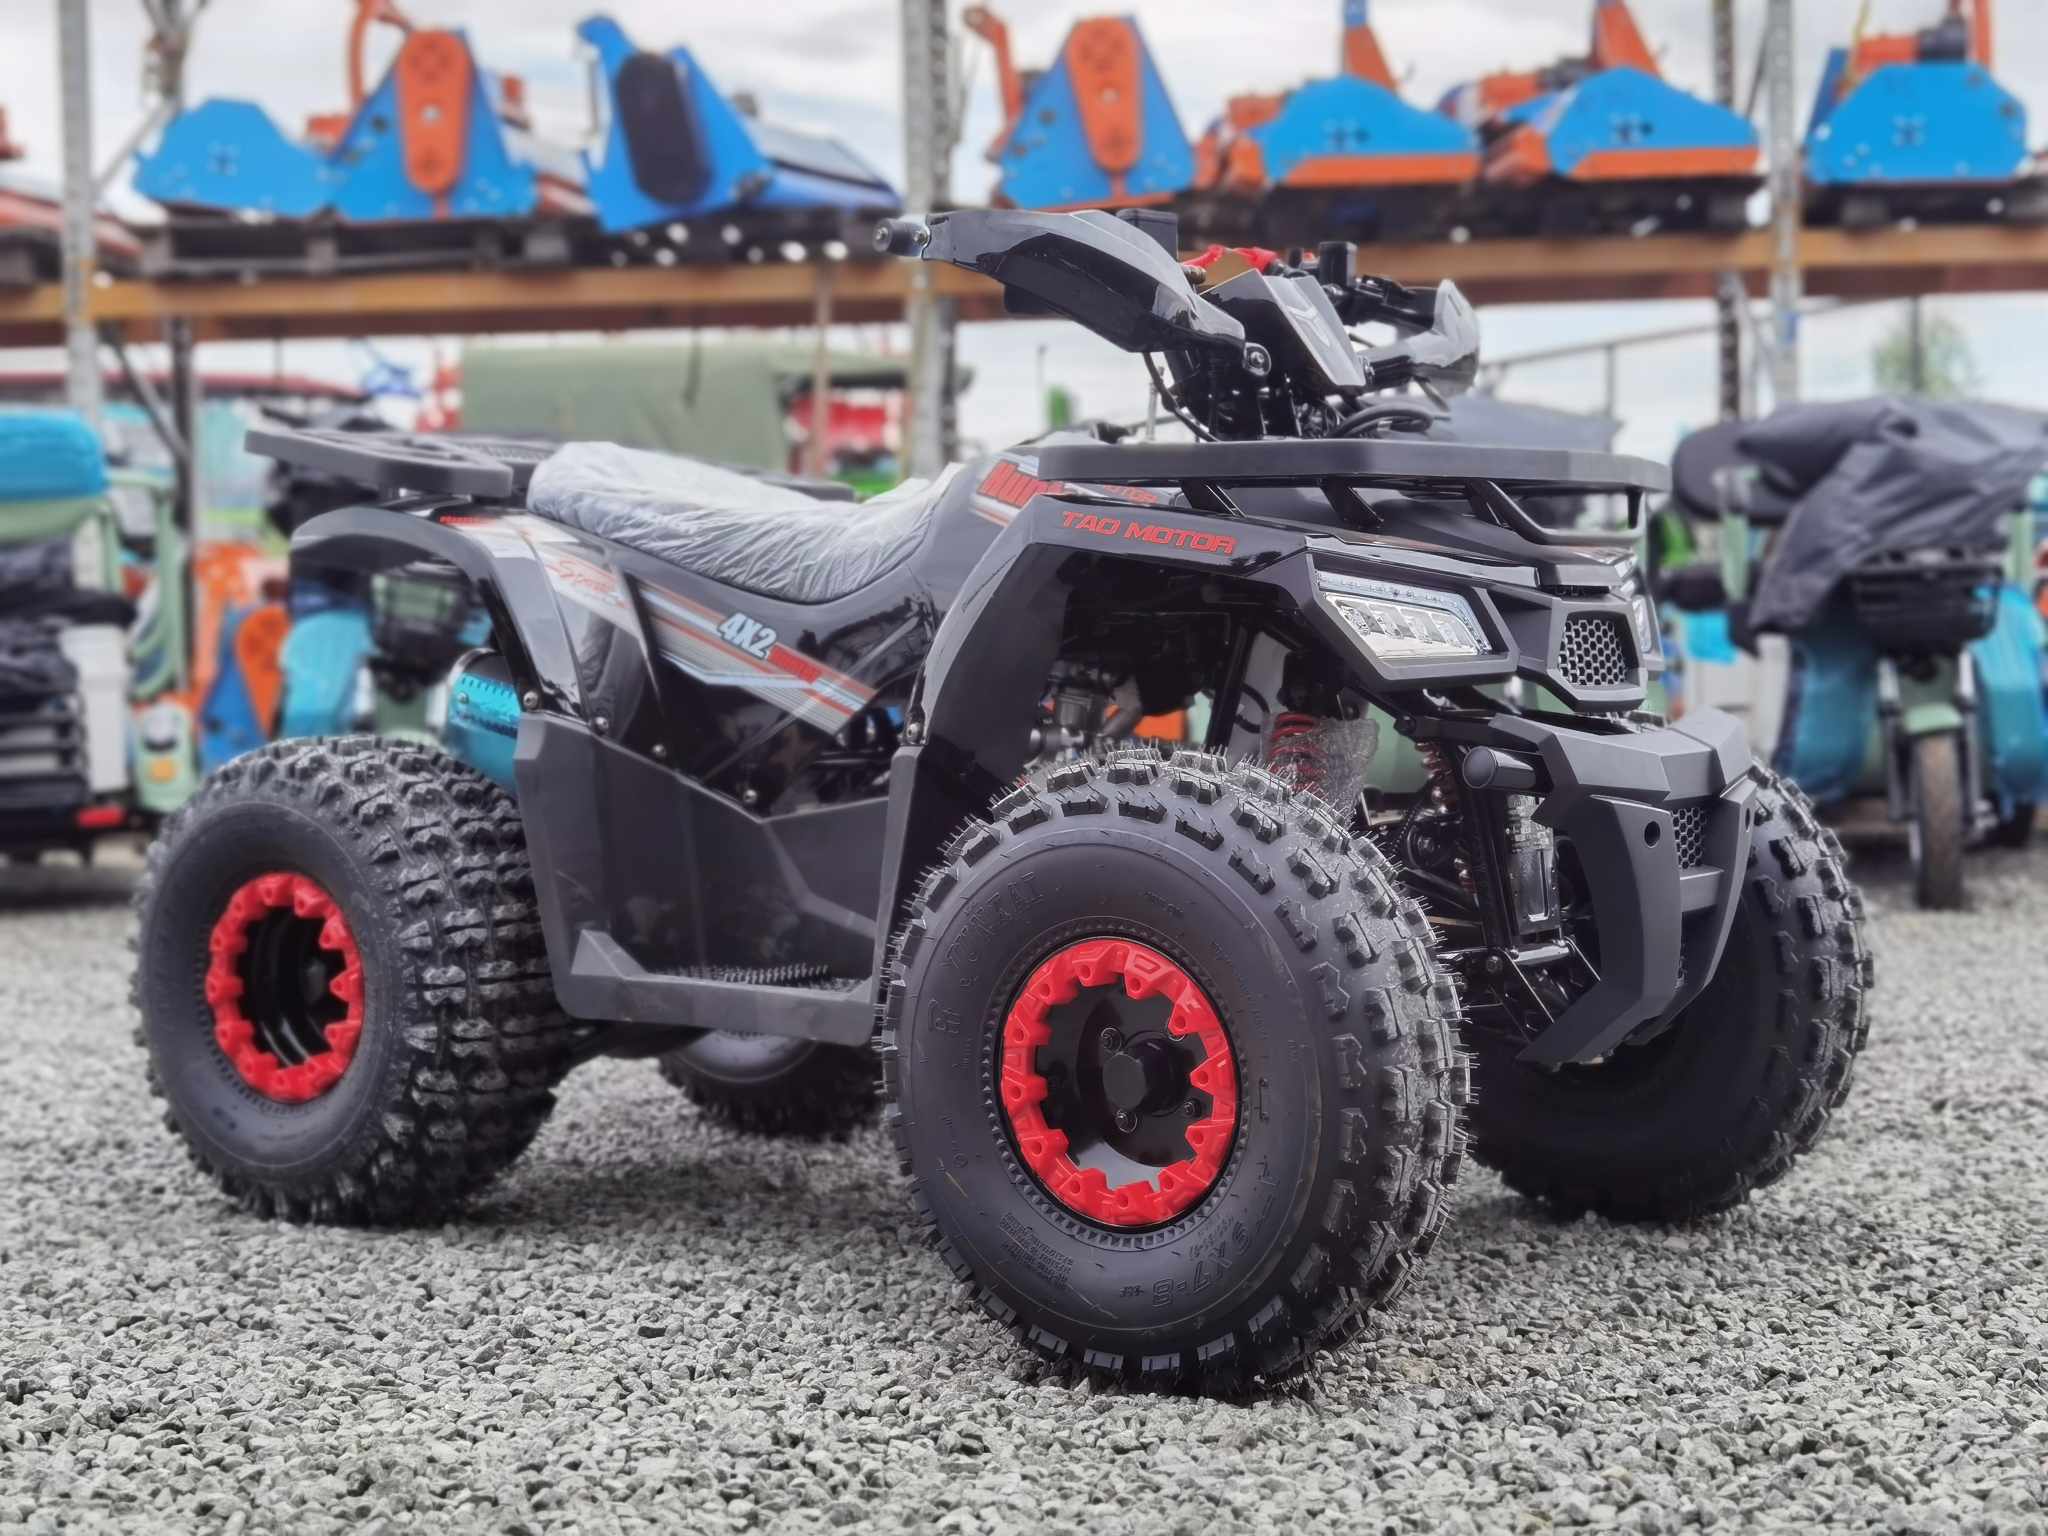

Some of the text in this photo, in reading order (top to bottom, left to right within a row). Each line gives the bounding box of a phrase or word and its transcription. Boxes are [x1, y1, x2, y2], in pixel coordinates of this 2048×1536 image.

[1062, 511, 1238, 555] TAO MOTOR
[718, 612, 777, 660] 4X2
